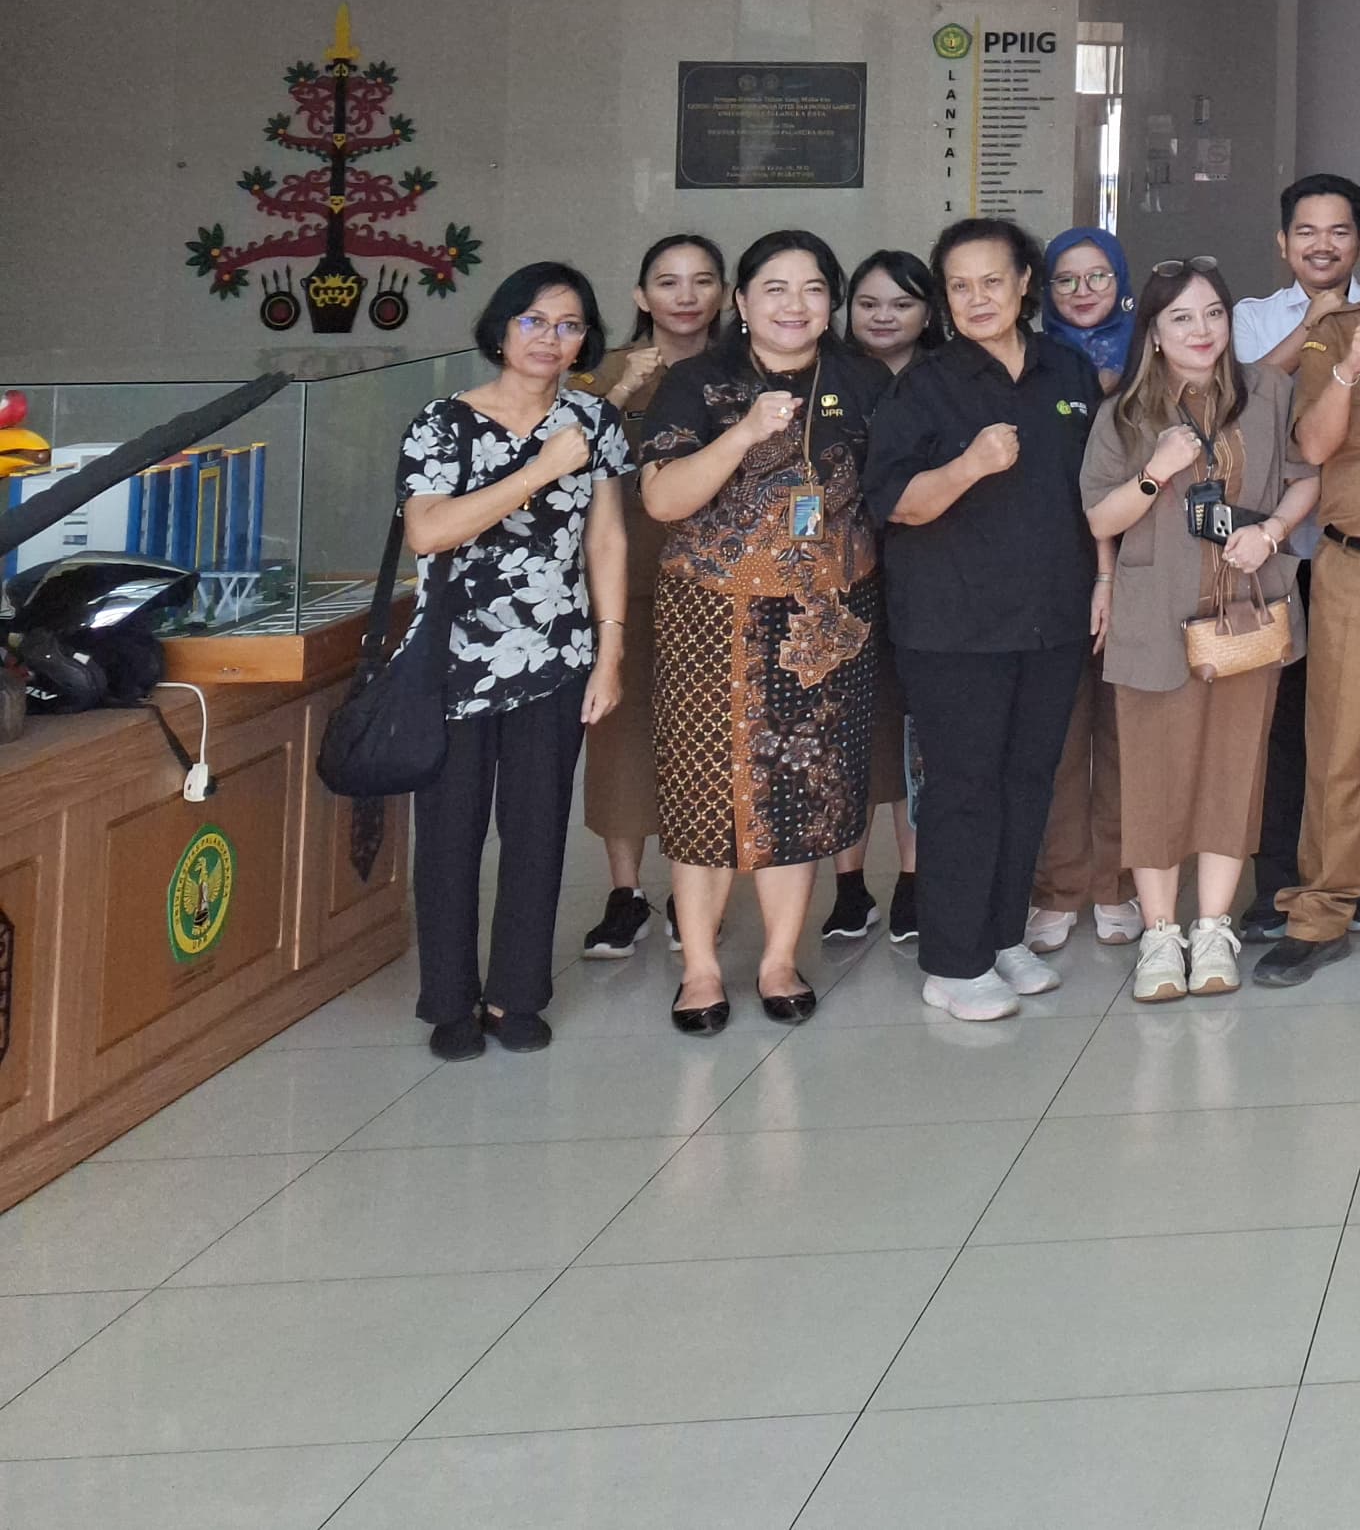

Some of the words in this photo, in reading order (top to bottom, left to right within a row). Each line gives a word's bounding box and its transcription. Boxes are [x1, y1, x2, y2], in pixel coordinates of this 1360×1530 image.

[984, 32, 1056, 53] PPIIG
[944, 201, 952, 211] 1
[821, 408, 843, 417] UPR
